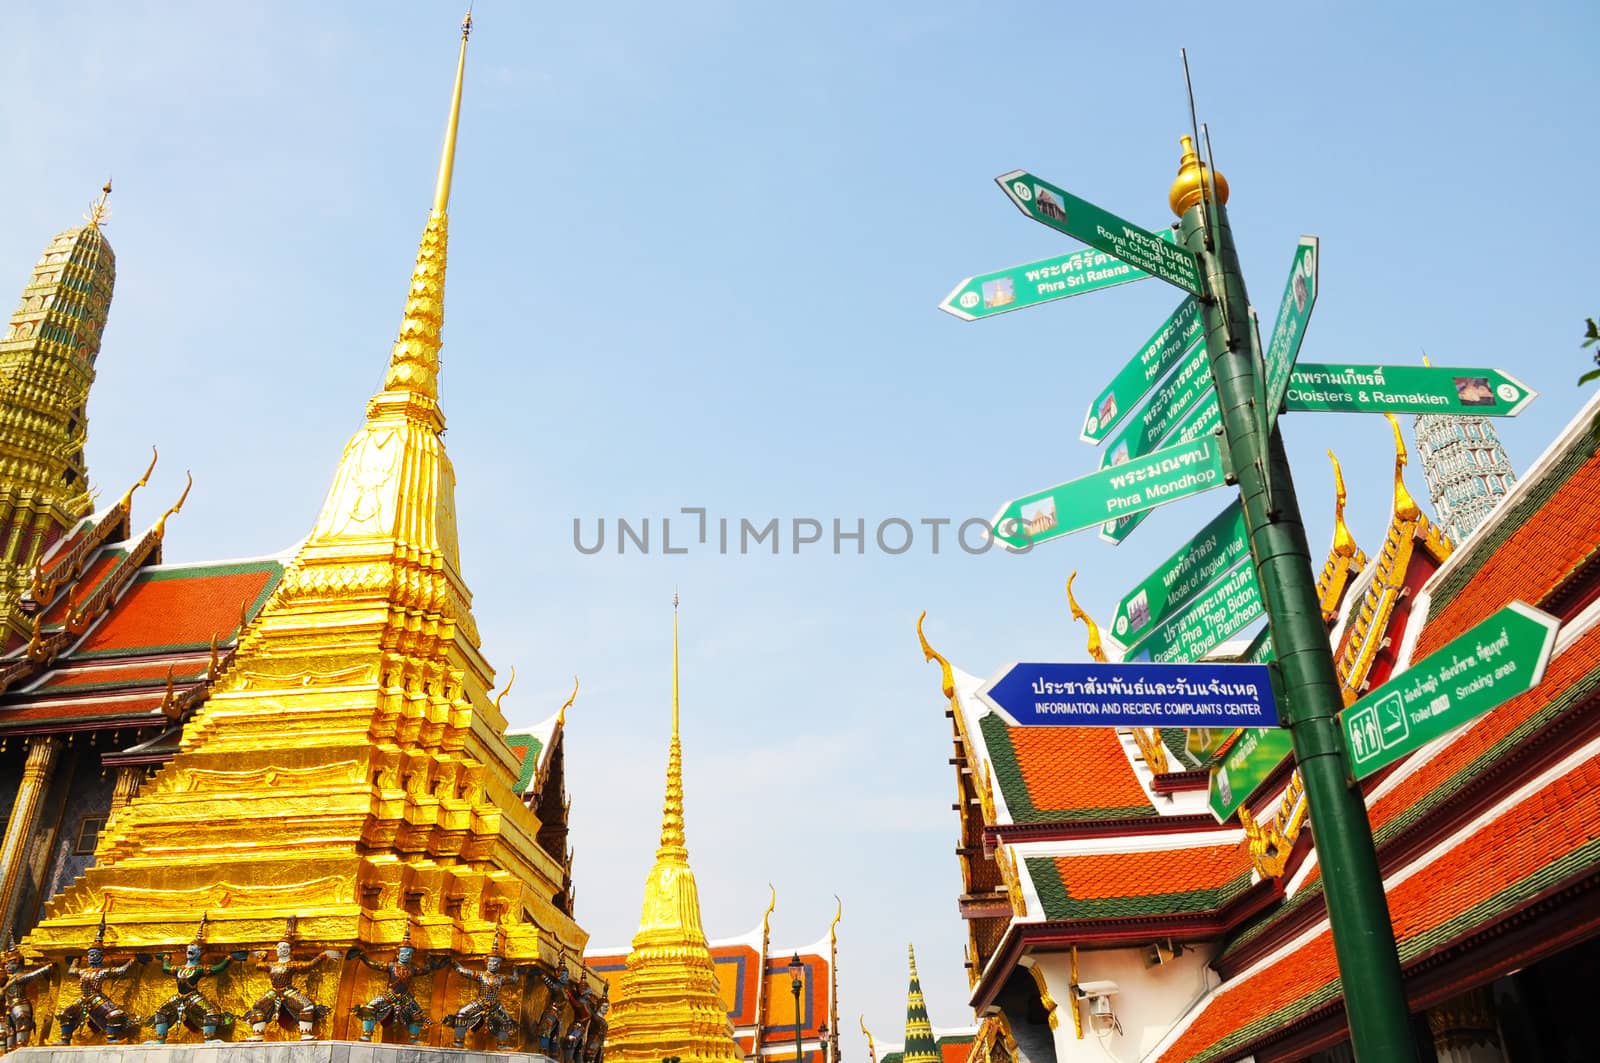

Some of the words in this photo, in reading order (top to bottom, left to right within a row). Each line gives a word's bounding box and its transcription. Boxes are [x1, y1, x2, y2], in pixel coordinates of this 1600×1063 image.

[1096, 224, 1127, 247] Royal
[1130, 239, 1164, 266] Chapel
[1166, 259, 1177, 271] of
[1178, 262, 1195, 280] the
[1115, 244, 1157, 273] Emerald
[1159, 266, 1198, 292] Buddha
[1037, 280, 1065, 295] Phra
[1067, 273, 1086, 288] Sri
[1087, 263, 1129, 284] Ratana
[1145, 361, 1160, 381] Hor
[1161, 340, 1182, 364] Phra
[1182, 318, 1201, 342] Nak
[1147, 418, 1167, 442] Phra
[1193, 366, 1212, 390] Yod
[1286, 389, 1353, 404] Cloisters
[1358, 391, 1370, 404] &
[1372, 391, 1450, 406] Ramakien
[1503, 386, 1514, 400] 3
[1106, 493, 1142, 513] Phra
[1145, 468, 1217, 499] Mondhop
[1167, 583, 1190, 607] Model
[1191, 574, 1199, 587] of
[1200, 553, 1226, 579] Angkor
[1226, 537, 1244, 558] Wat
[1181, 625, 1203, 649] Phra
[1203, 607, 1226, 633] Thep
[1190, 634, 1216, 658] Royal
[1216, 600, 1262, 640] Pantheon
[1032, 676, 1258, 702] ประชาสัมพันธ์และรับแจ้งเหตุ
[1035, 702, 1099, 715] INFORMATION
[1101, 702, 1121, 715] AND
[1123, 702, 1163, 716] RECIEVE
[1164, 702, 1223, 716] COMPLAINTS
[1224, 702, 1262, 716] CENTER
[1410, 707, 1432, 725] Toilet
[1455, 673, 1494, 701] Smoking
[1494, 660, 1517, 680] area
